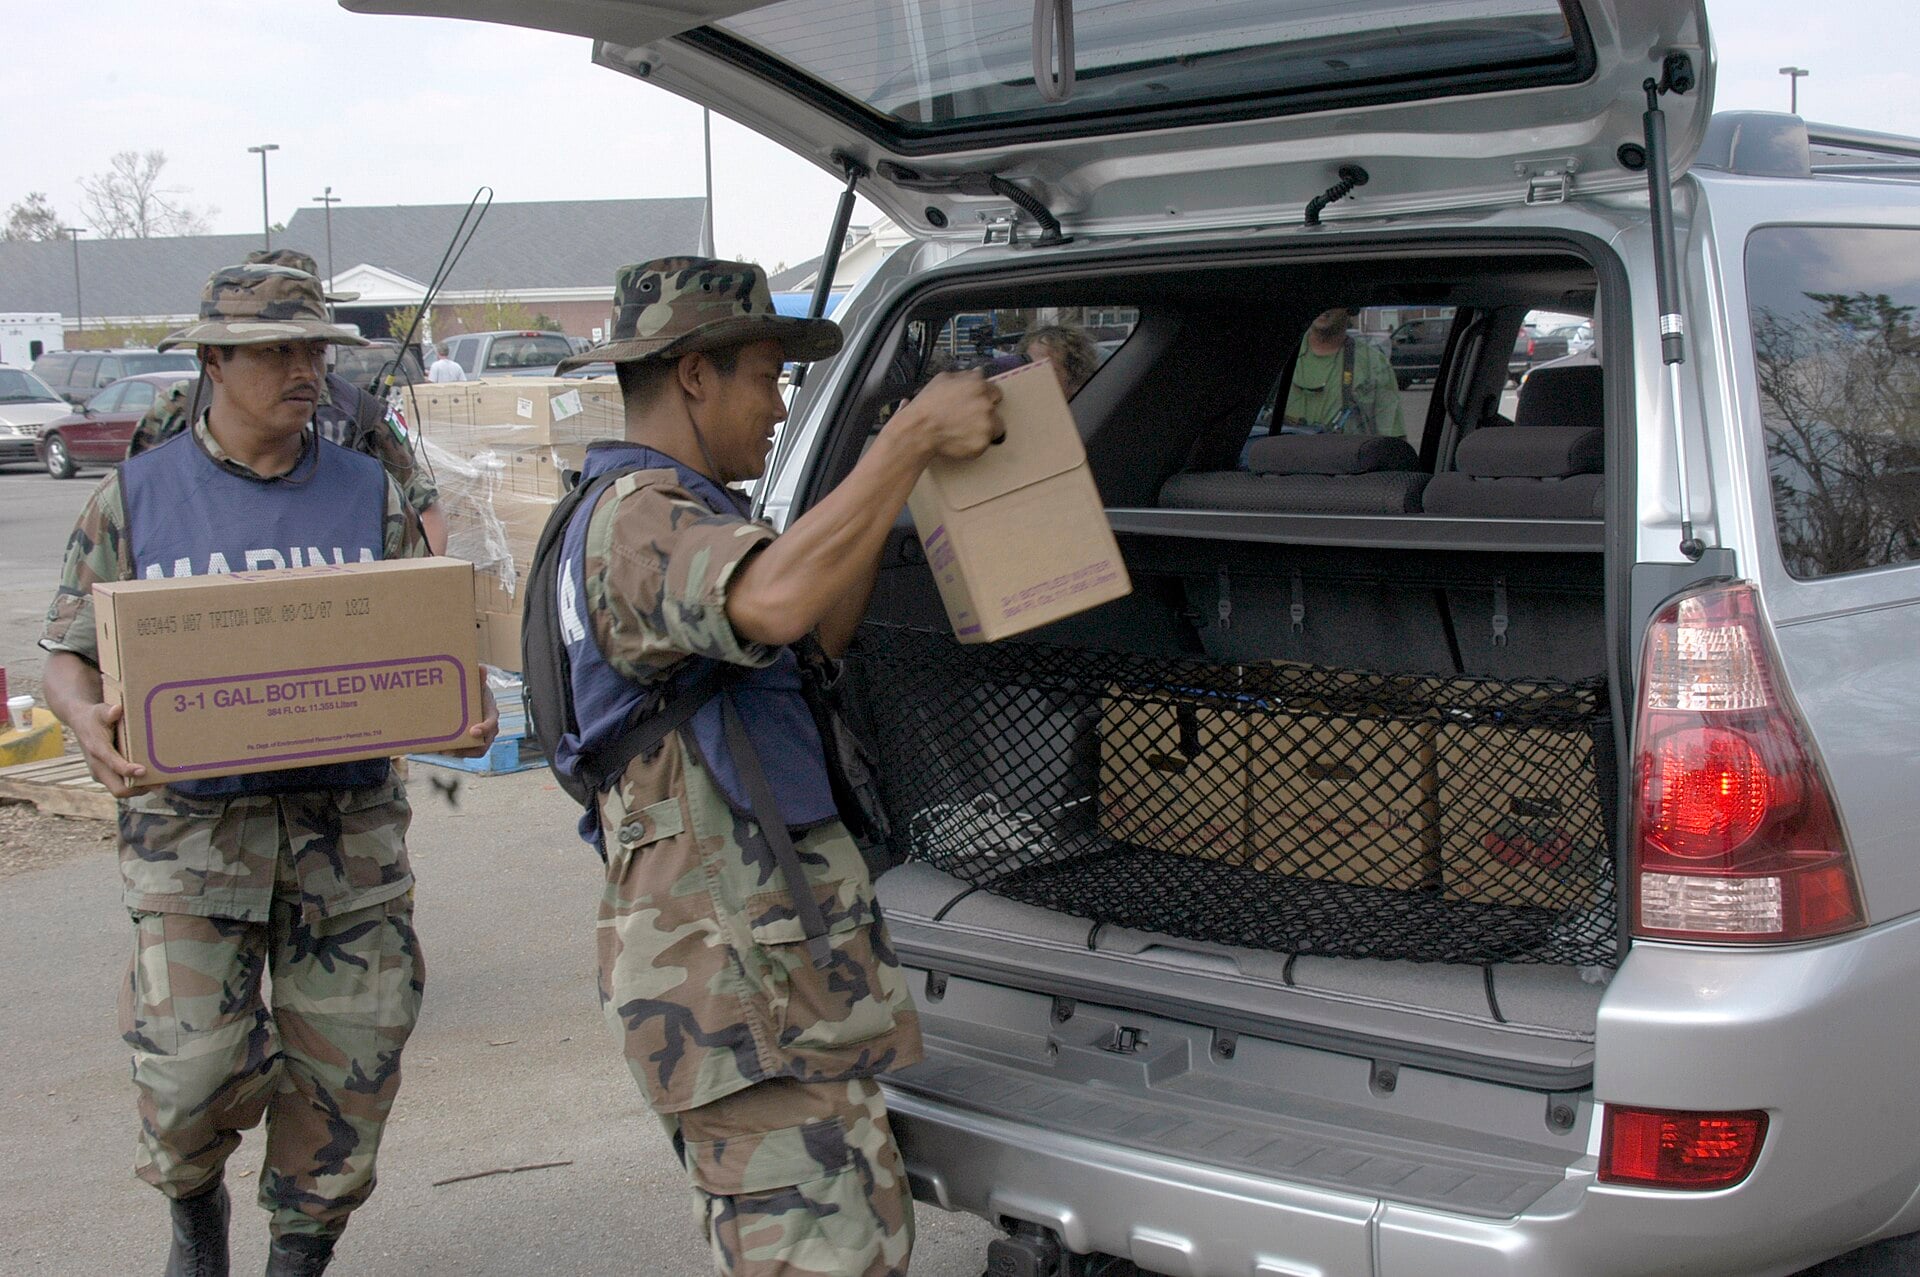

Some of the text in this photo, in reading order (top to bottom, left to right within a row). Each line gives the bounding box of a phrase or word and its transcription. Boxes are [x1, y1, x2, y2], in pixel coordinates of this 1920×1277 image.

[209, 608, 249, 630] TRITON
[173, 691, 206, 713] 3-1
[266, 675, 366, 703] BOTTLED
[369, 667, 444, 692] WATER
